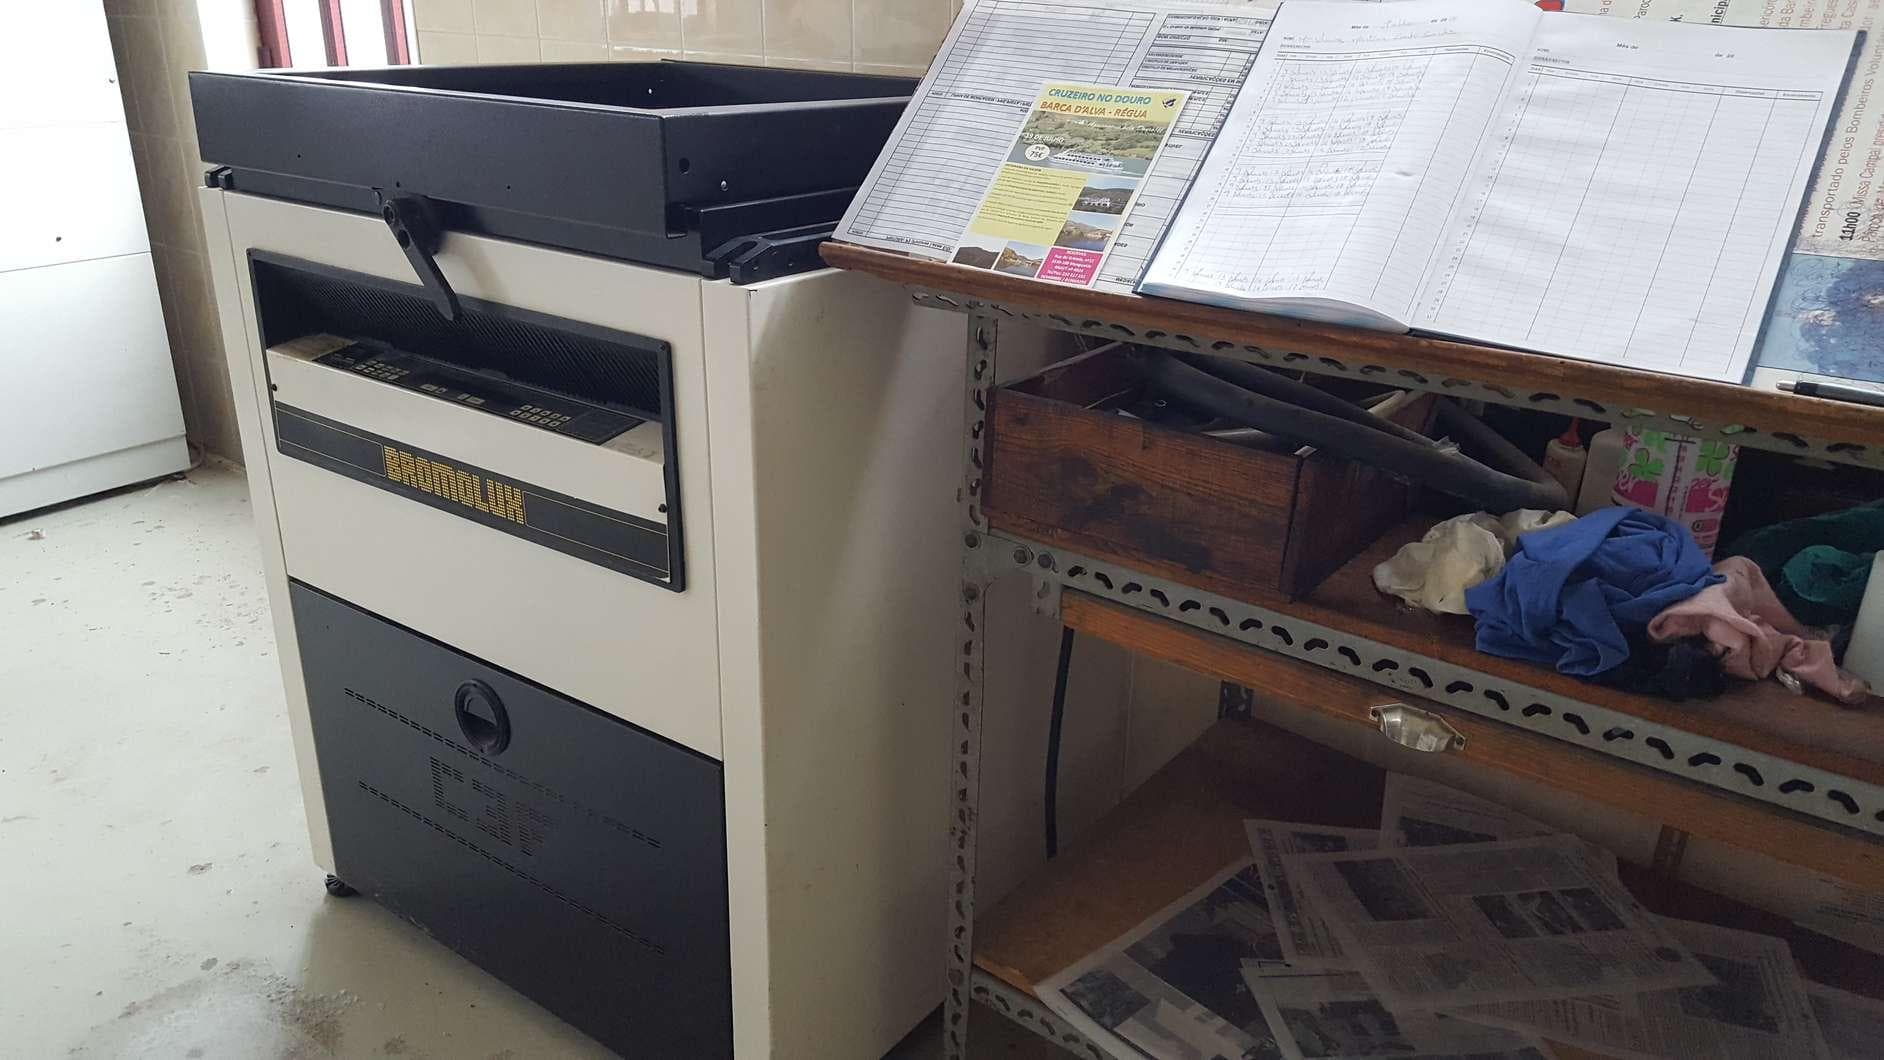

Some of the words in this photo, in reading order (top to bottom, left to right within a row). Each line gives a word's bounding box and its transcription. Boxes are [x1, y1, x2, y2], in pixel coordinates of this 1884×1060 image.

[1040, 101, 1072, 113] BARCA
[1074, 105, 1106, 115] D'ALVA
[1116, 107, 1148, 118] RÉGUA
[1048, 88, 1095, 101] CRUZEIRO
[1097, 93, 1114, 102] NO
[1116, 95, 1151, 105] DOURO
[1846, 79, 1874, 134] Bombeiros
[1838, 135, 1855, 166] pelos
[1812, 167, 1844, 237] transportado
[1840, 211, 1861, 241] 11h00
[383, 445, 525, 525] BROMOLUX
